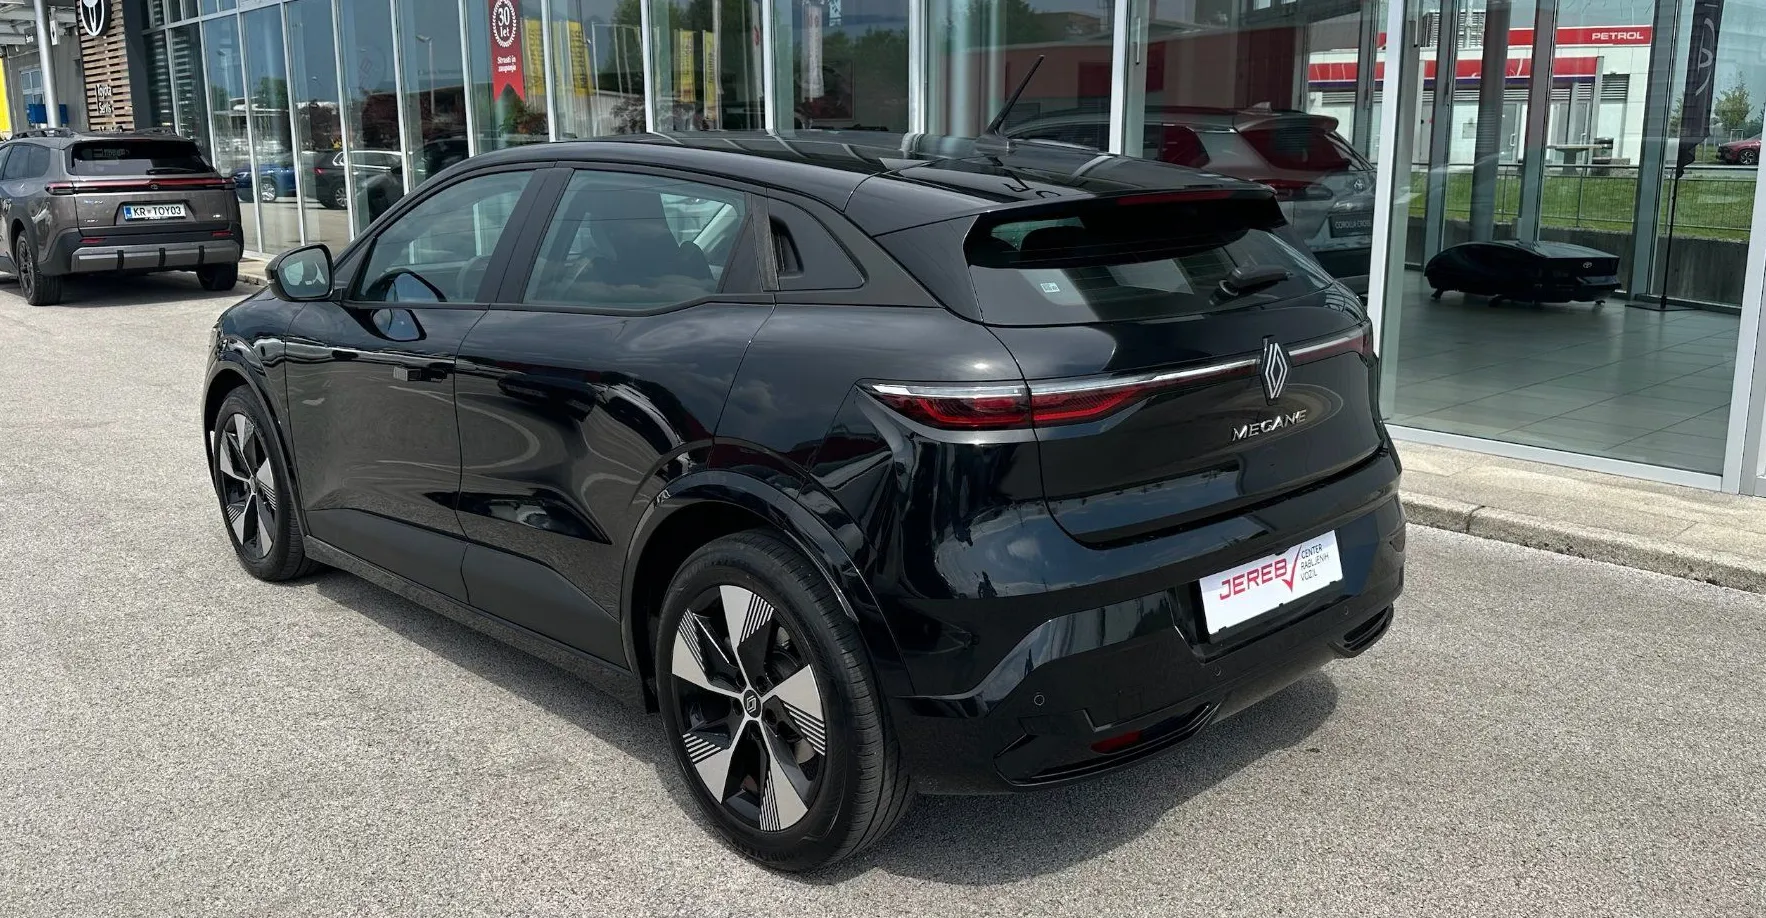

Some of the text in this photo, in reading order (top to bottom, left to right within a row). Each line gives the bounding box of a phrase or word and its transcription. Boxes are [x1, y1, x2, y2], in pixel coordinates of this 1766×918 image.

[497, 7, 510, 26] 30
[500, 26, 510, 37] let
[1591, 31, 1644, 41] PETROL
[97, 83, 112, 98] Toyota
[99, 102, 113, 115] Servis
[133, 205, 181, 217] KR TOY03
[1232, 410, 1307, 441] MEGANE
[1301, 544, 1323, 559] CENTER
[1300, 553, 1330, 570] RABLJENIH
[1220, 558, 1287, 600] JEREB
[1300, 570, 1318, 581] VOZIL
